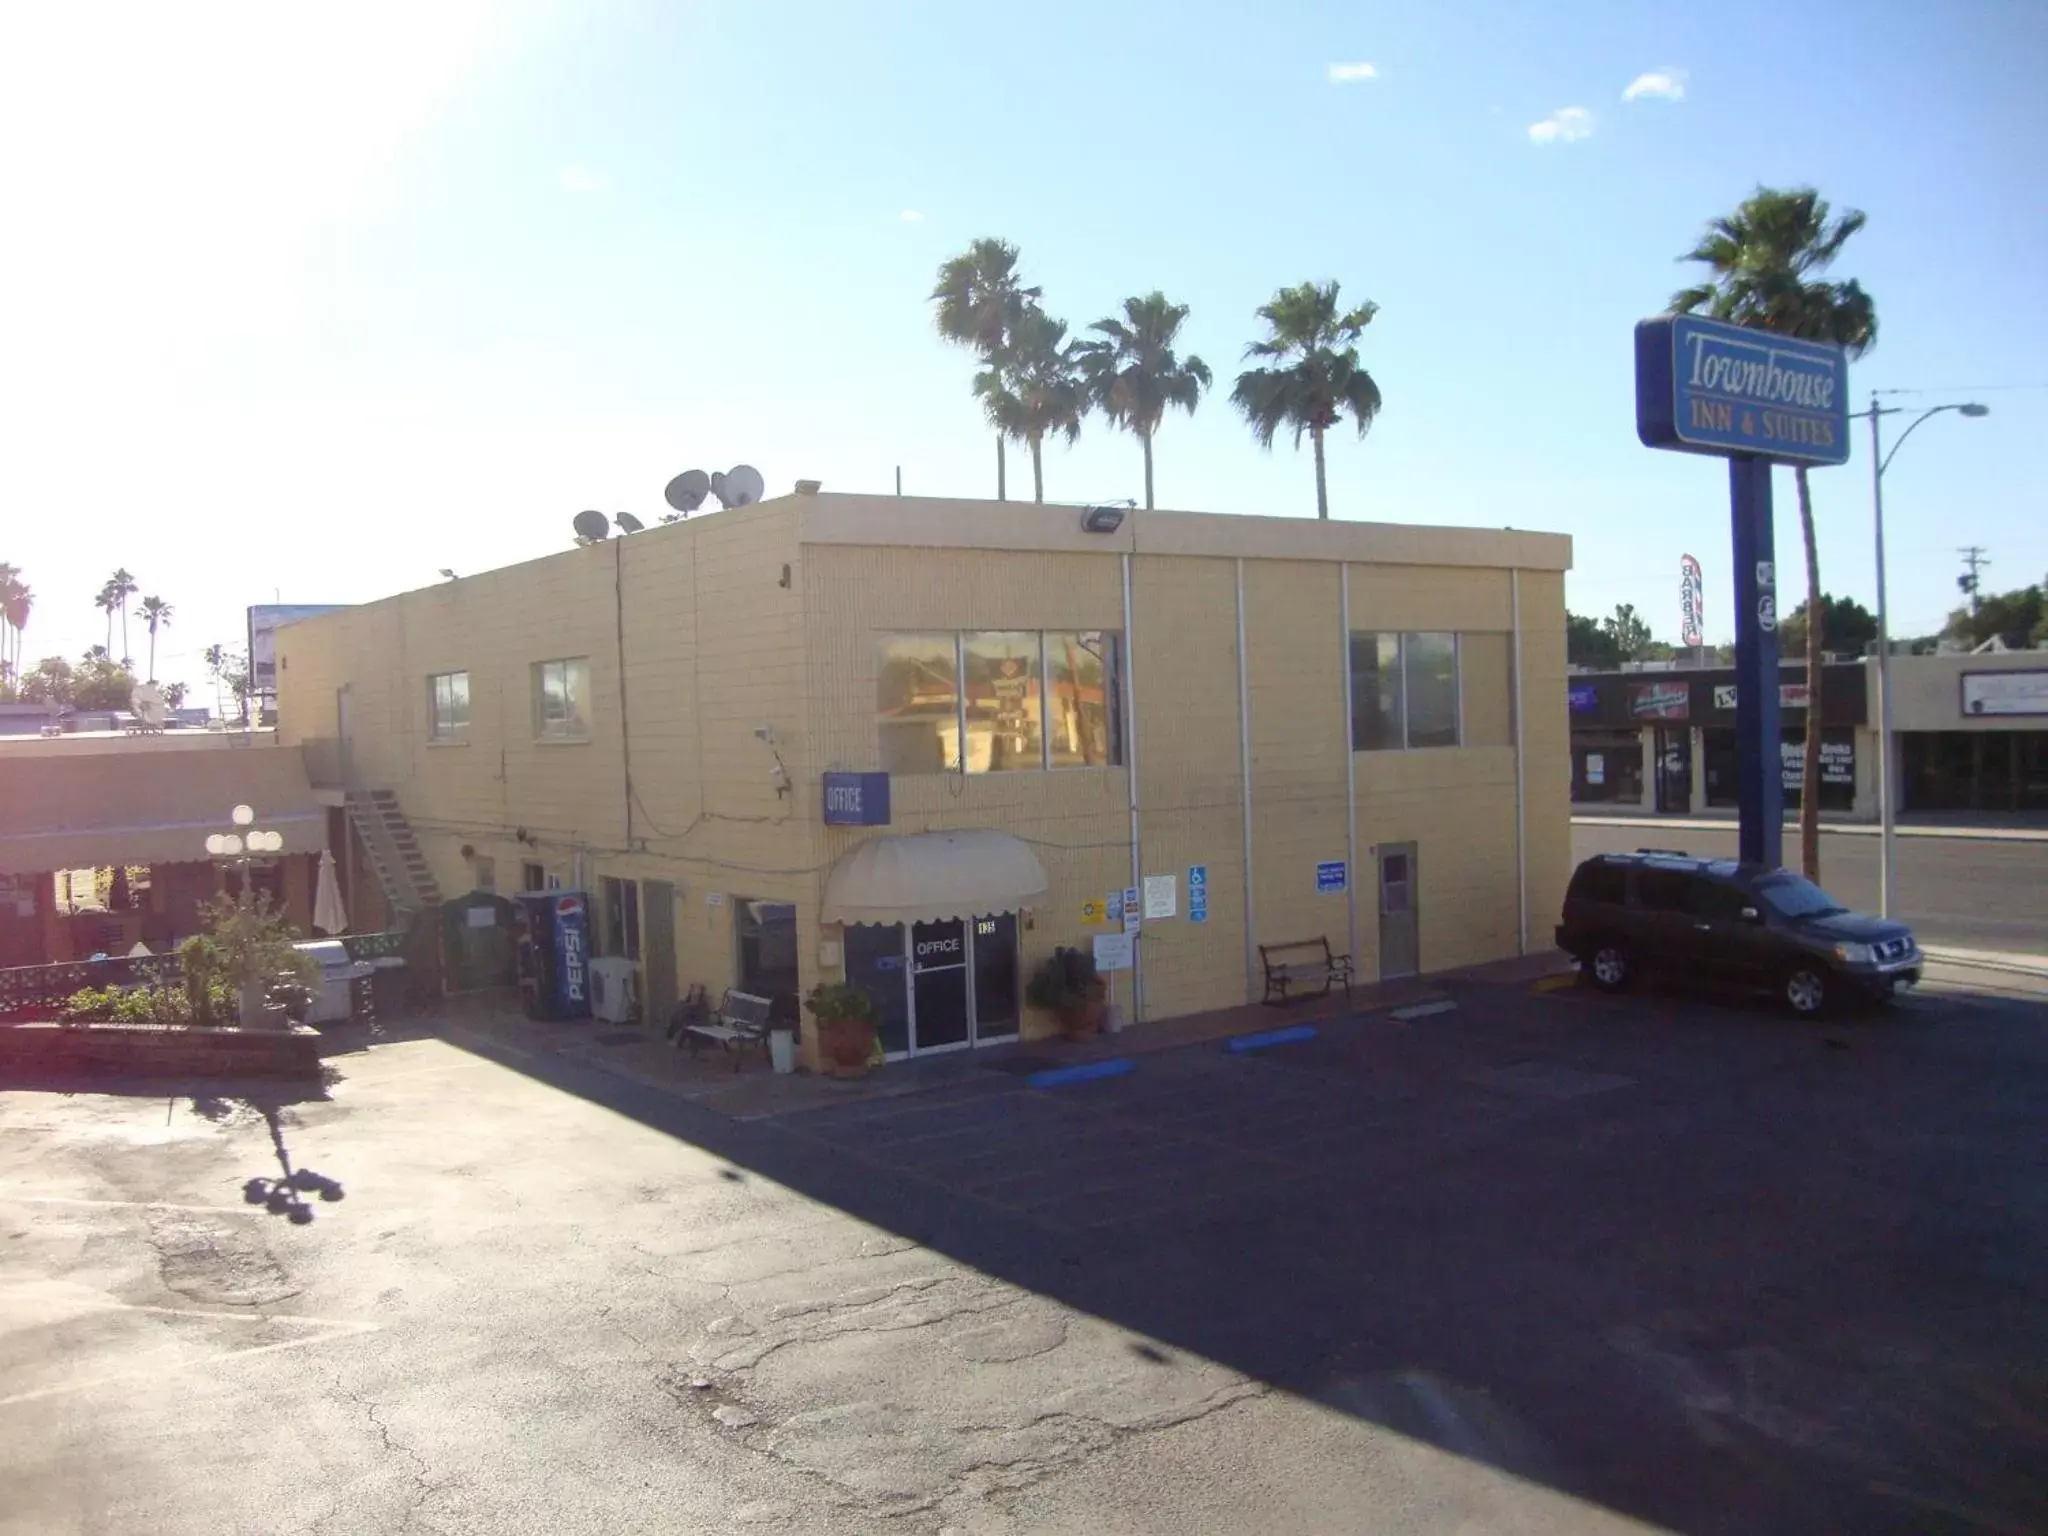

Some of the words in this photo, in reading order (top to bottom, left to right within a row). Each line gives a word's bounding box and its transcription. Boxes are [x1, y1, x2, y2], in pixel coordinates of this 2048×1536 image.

[1687, 332, 1834, 407] Townhouse
[1691, 398, 1732, 433] INN
[1763, 411, 1834, 445] SUITES
[827, 786, 862, 812] OFFICE
[564, 928, 585, 1001] PEPSI
[917, 938, 960, 955] OFFICE
